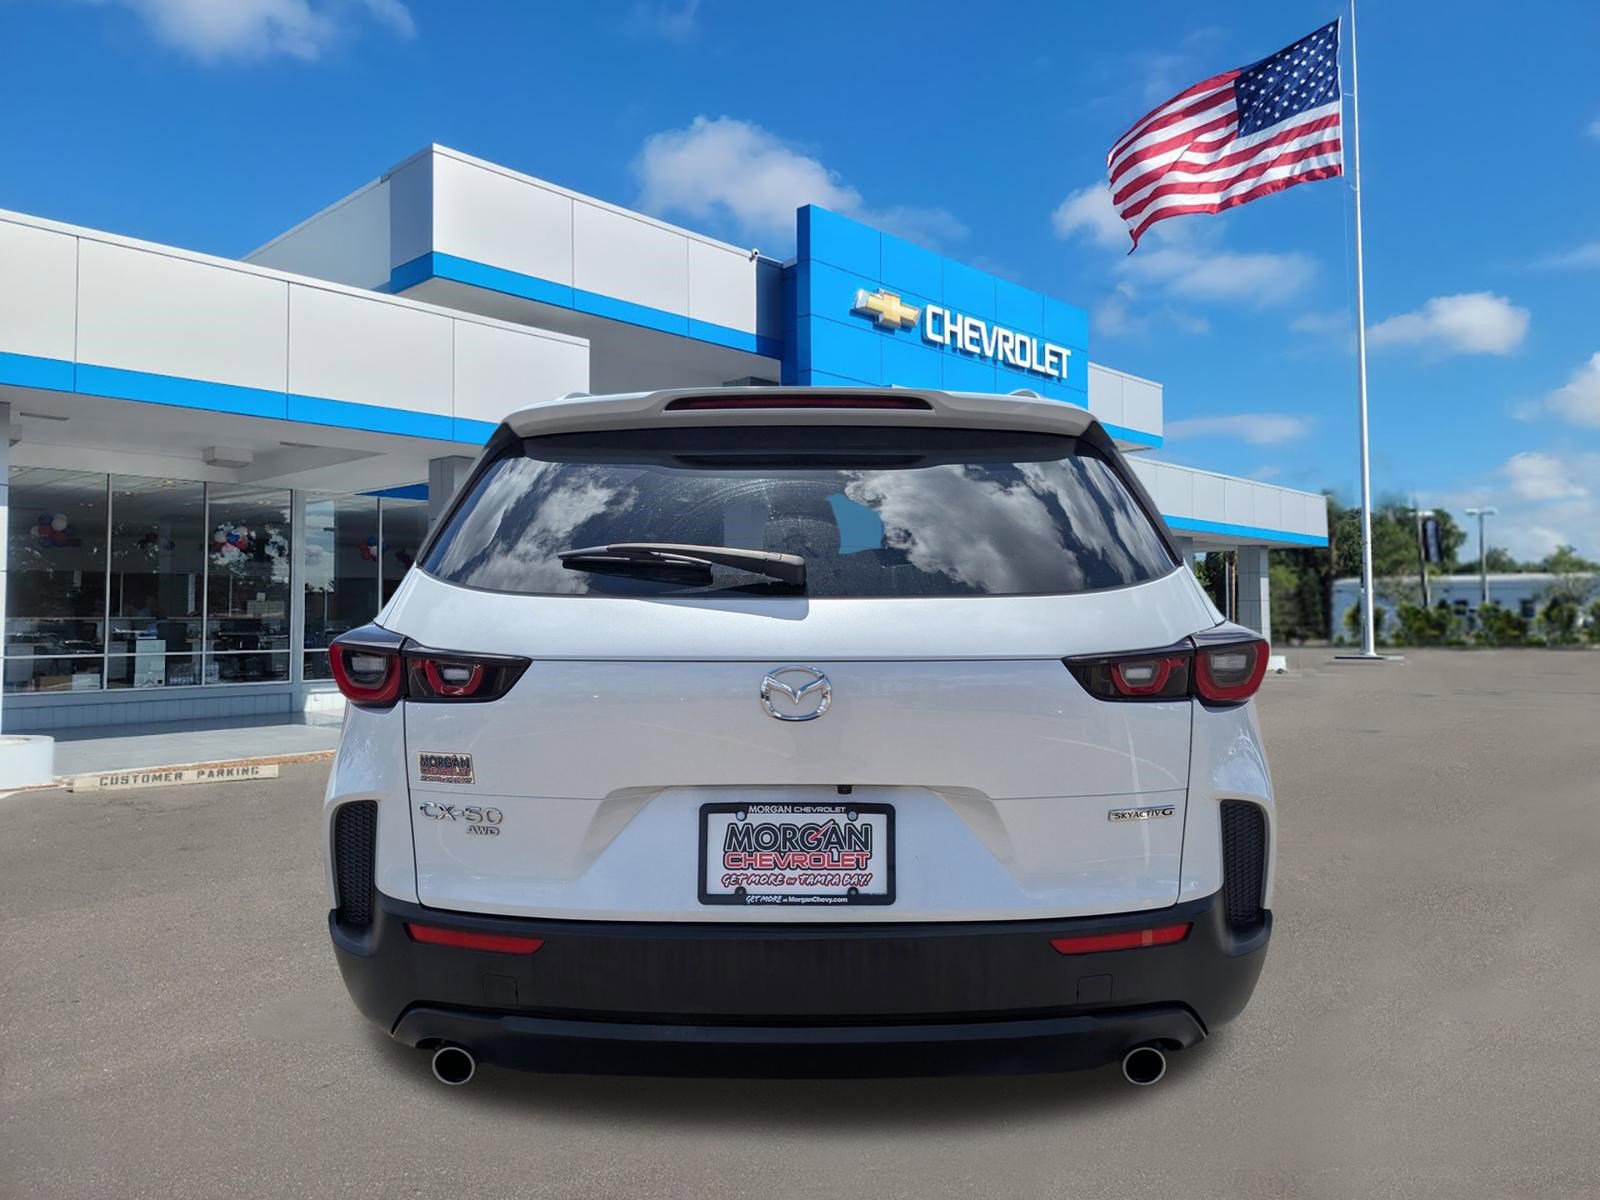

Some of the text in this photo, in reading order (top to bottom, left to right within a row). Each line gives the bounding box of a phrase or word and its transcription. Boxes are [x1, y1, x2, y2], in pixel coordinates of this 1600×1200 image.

[926, 304, 1072, 379] CHEVROLET
[420, 754, 471, 768] MORGAN
[100, 766, 259, 786] CUSTOMER PARKING
[420, 801, 503, 825] CX-50
[748, 805, 792, 813] MORGAN
[467, 825, 500, 836] AWD
[724, 819, 872, 851] MORGAN
[724, 851, 871, 870] CHEVROLET
[721, 873, 747, 888] GET
[748, 874, 785, 885] MORE
[799, 873, 841, 886] TAMPA
[842, 873, 873, 886] BAY!
[745, 895, 760, 904] GET
[760, 895, 782, 903] MORE
[788, 896, 848, 904] MorganChevy.com
